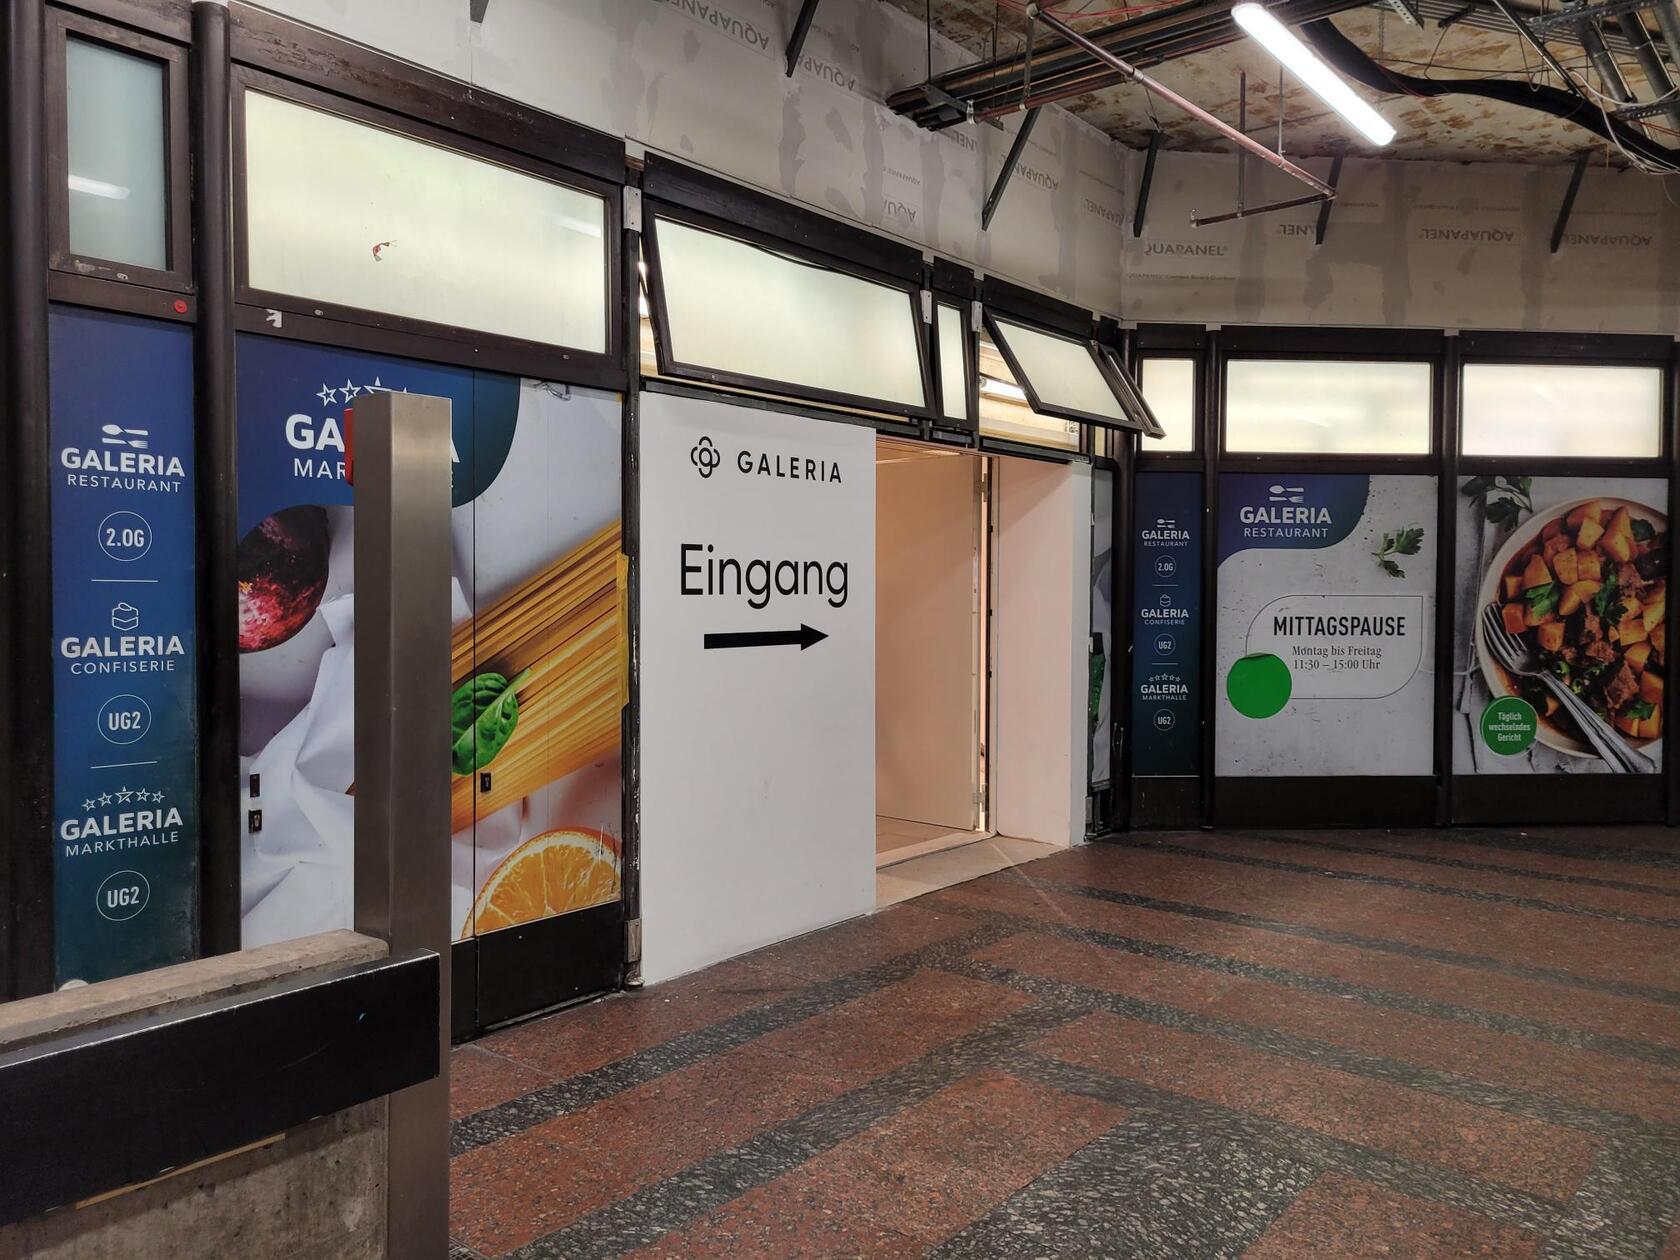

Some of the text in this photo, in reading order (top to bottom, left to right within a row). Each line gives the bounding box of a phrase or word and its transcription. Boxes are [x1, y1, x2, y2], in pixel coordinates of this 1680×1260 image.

[666, 0, 770, 50] AQUAPAN
[1421, 228, 1515, 242] AQUAPANEL
[1564, 233, 1653, 246] AQUAPANE
[61, 447, 186, 478] GALERIA
[737, 450, 842, 484] GALERIA
[67, 473, 182, 493] RESTAURANT
[1239, 506, 1333, 525] GALERIA
[106, 527, 145, 548] 2.0G
[1141, 530, 1190, 540] GALERIA
[1244, 527, 1329, 539] RESTAURANT
[681, 543, 848, 610] Eingang
[1141, 608, 1190, 619] GALERIA
[1273, 616, 1406, 636] MITTAGSPAUSE
[60, 635, 185, 658] GALERIA
[1158, 640, 1173, 650] UG2
[1292, 645, 1383, 659] Montag bis Freitag
[71, 659, 176, 675] CONFISERIE
[1293, 659, 1320, 671] 11:30
[1333, 659, 1360, 671] 15:00
[1362, 659, 1381, 670] Uhr
[1140, 684, 1189, 695] GALERIA
[108, 711, 141, 731] UG2
[1157, 715, 1172, 725] UG2
[60, 807, 184, 841] GALERIA
[66, 830, 180, 857] MARKTHALLE
[107, 885, 140, 909] UG2
